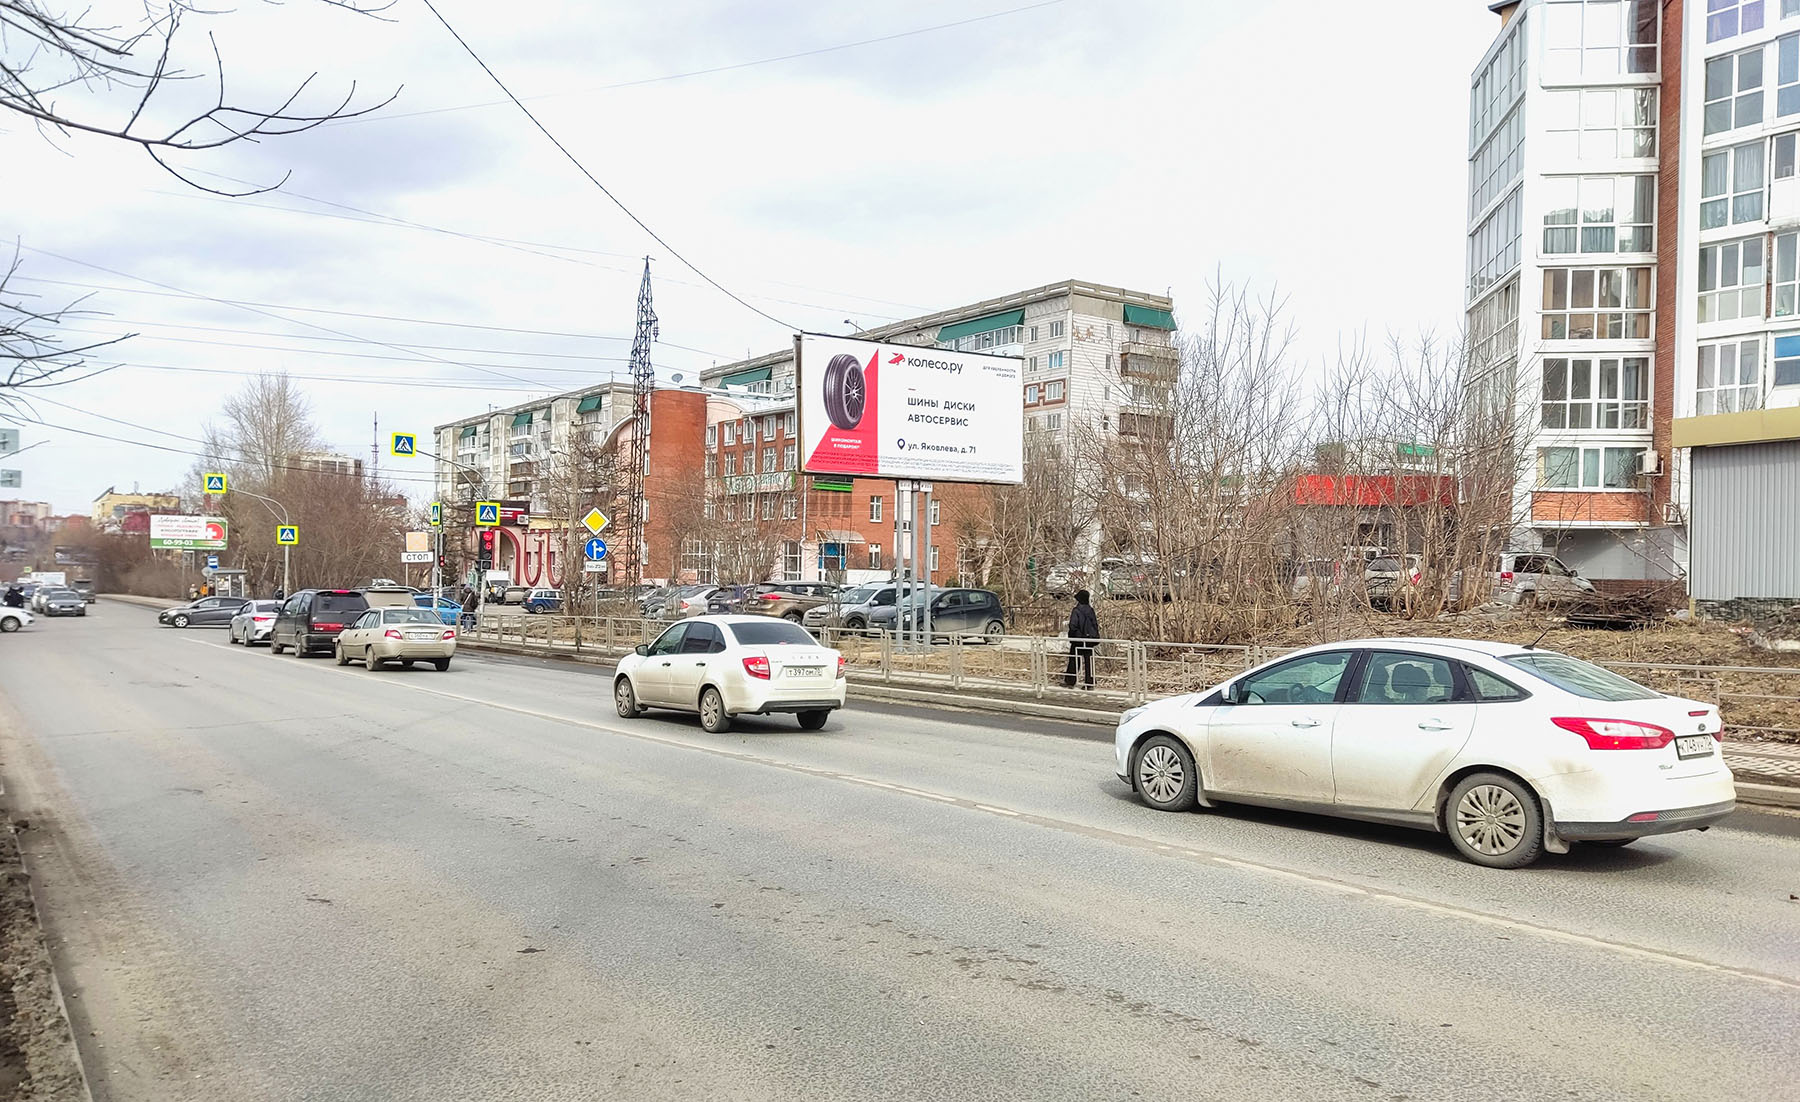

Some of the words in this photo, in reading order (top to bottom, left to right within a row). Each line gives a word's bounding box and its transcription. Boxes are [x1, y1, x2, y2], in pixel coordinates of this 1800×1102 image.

[908, 357, 963, 374] колесо.ру
[907, 397, 938, 408] ШИНЫ
[944, 400, 975, 411] ДИСКИ
[907, 414, 969, 427] АВТОСЕРВИС
[908, 443, 919, 452] ул.
[921, 443, 958, 453] Яковлева,
[961, 445, 968, 454] д.
[969, 445, 976, 454] 71
